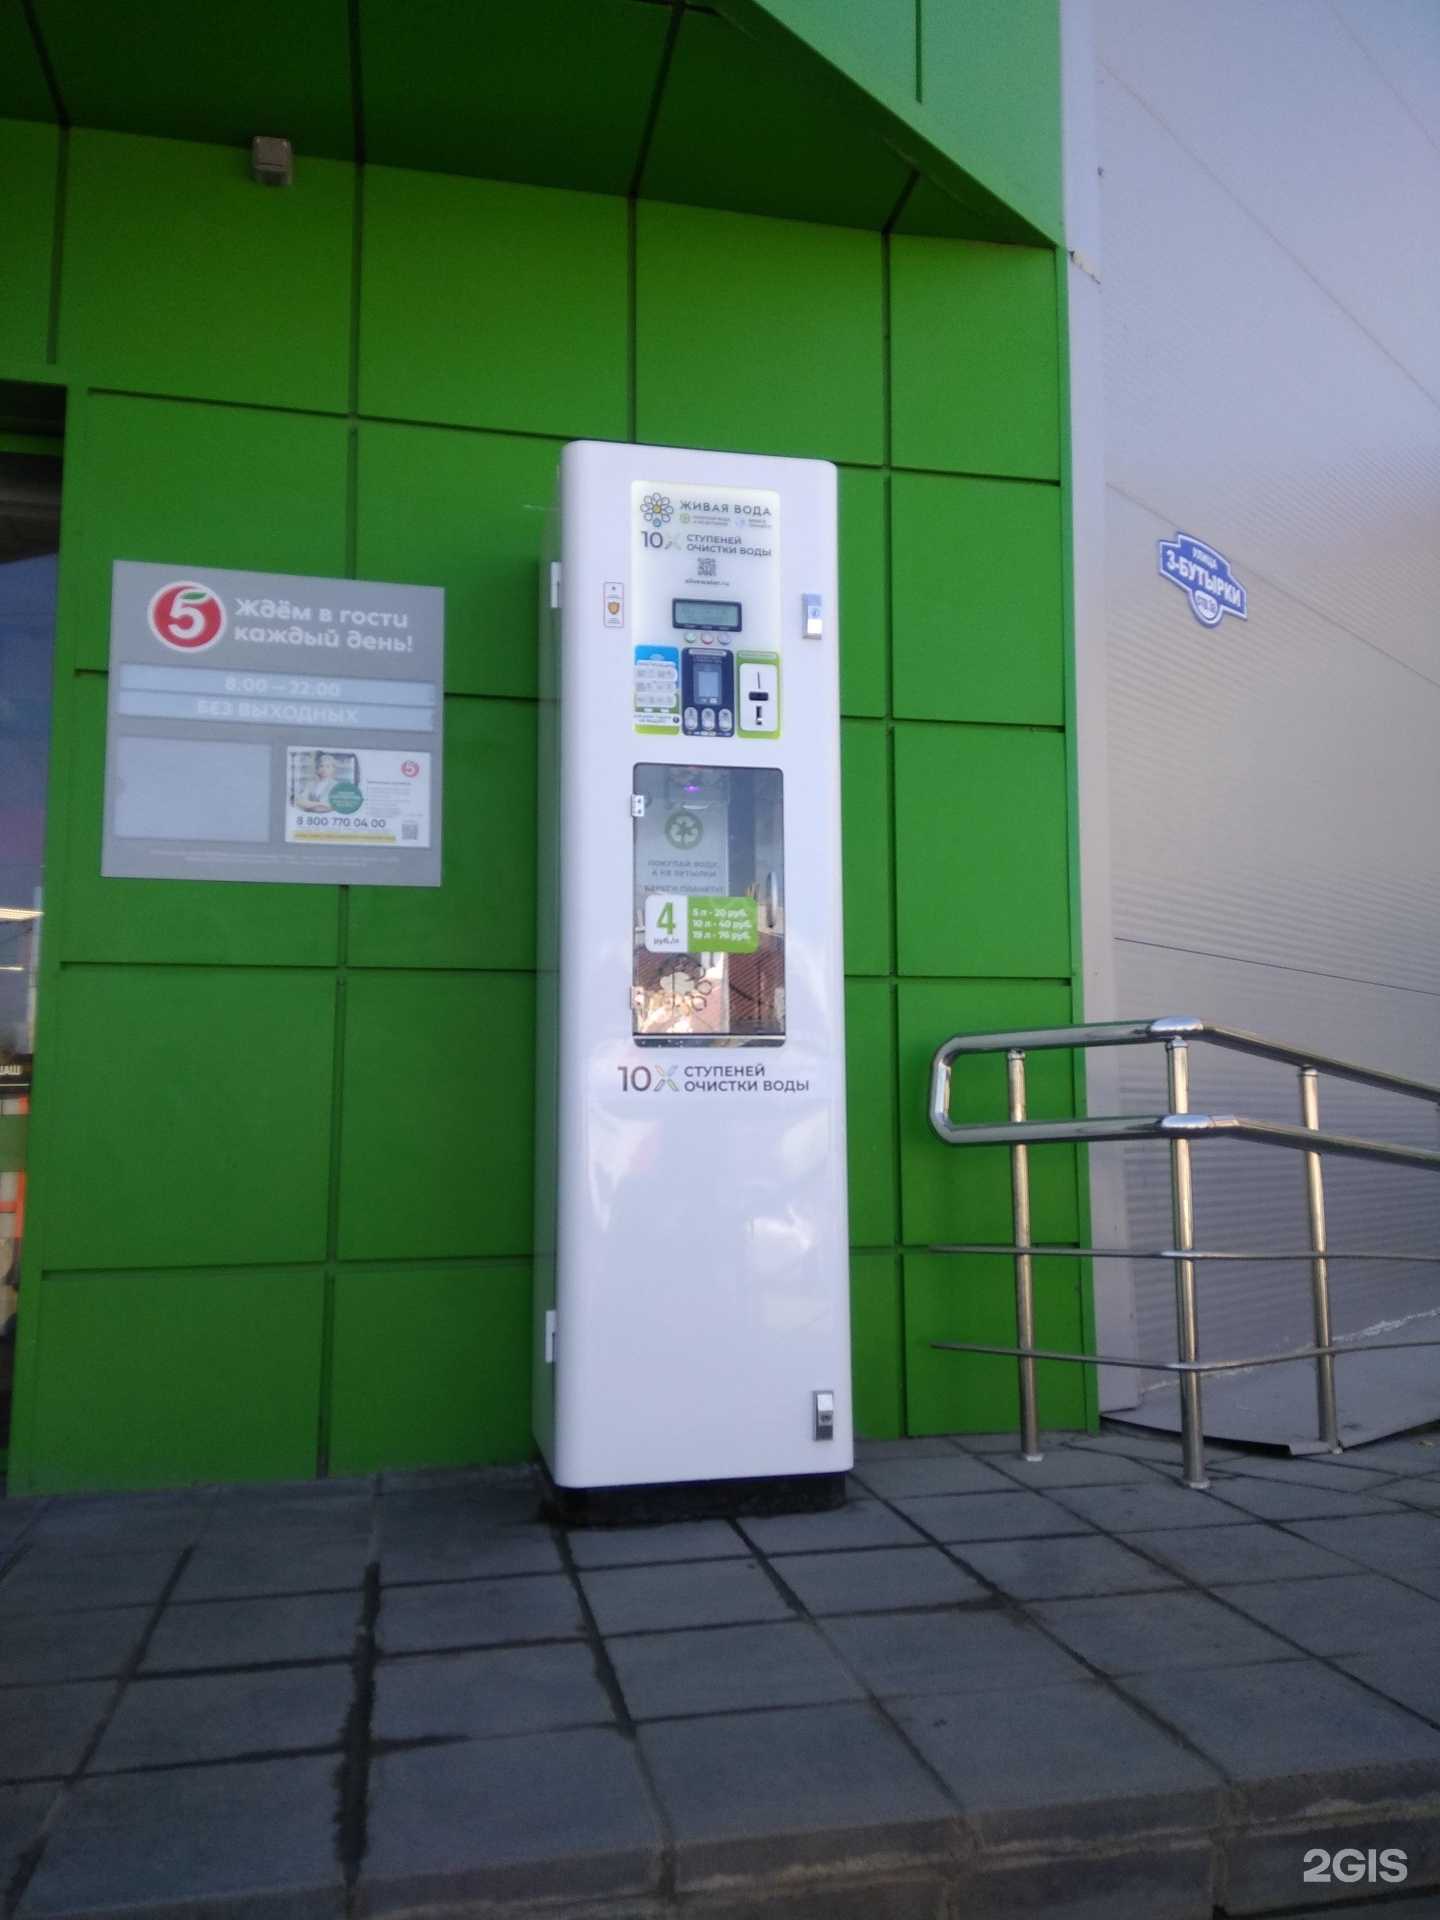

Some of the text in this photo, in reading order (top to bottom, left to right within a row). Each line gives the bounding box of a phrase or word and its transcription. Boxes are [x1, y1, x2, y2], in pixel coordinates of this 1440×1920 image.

[680, 500, 772, 517] ЖИВАЯ ВОДА
[686, 533, 742, 545] СТУПЕНЕЙ
[686, 543, 772, 557] ОЧИСТКИ ВОДЫ
[234, 598, 409, 628] Ждём в гости
[234, 625, 413, 652] каждый день!
[225, 676, 265, 695] 8:00
[197, 700, 359, 723] БЕЗ ВЫХОДНЫХ
[296, 816, 386, 828] 8 800 770 04 00
[656, 901, 677, 935] 4
[692, 919, 703, 929] 10
[684, 1063, 766, 1078] СТУПЕНЕЙ
[684, 1080, 809, 1093] ОЧИСТКИ ВОДЫ
